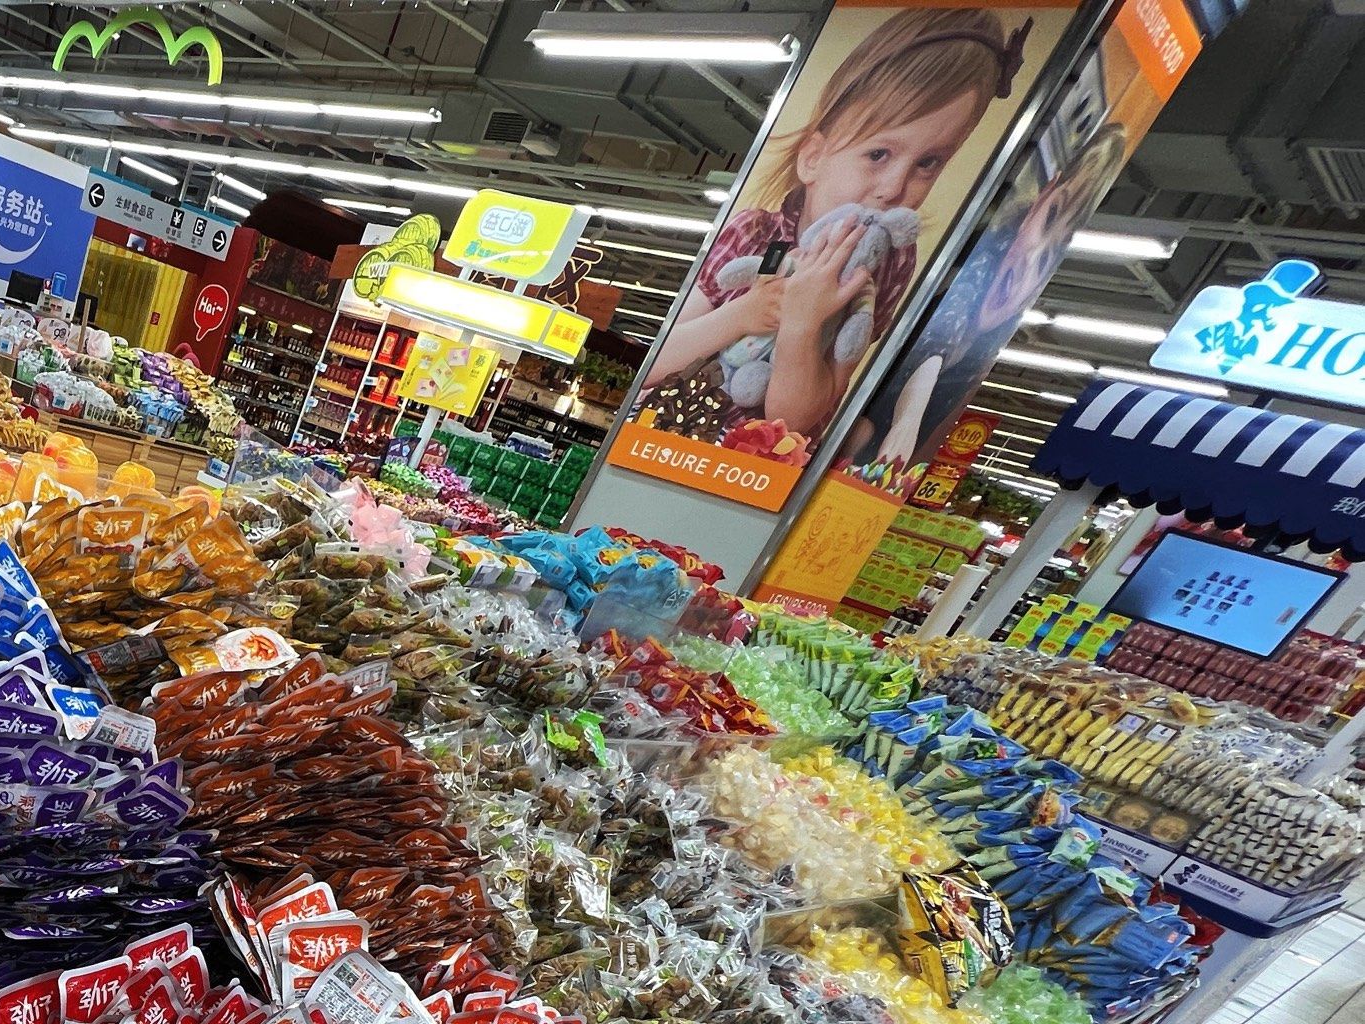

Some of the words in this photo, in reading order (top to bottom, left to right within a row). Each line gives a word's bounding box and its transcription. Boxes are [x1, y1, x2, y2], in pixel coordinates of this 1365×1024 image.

[114, 195, 156, 221] 生鲜食品区
[1266, 321, 1365, 381] HO
[629, 439, 712, 476] LEISURE
[712, 462, 771, 492] FOOD
[1331, 496, 1365, 518] 我
[94, 517, 134, 538] 劲仔
[35, 757, 84, 787] 劲仔
[302, 931, 351, 969] 劲仔
[78, 976, 123, 1018] 劲仔
